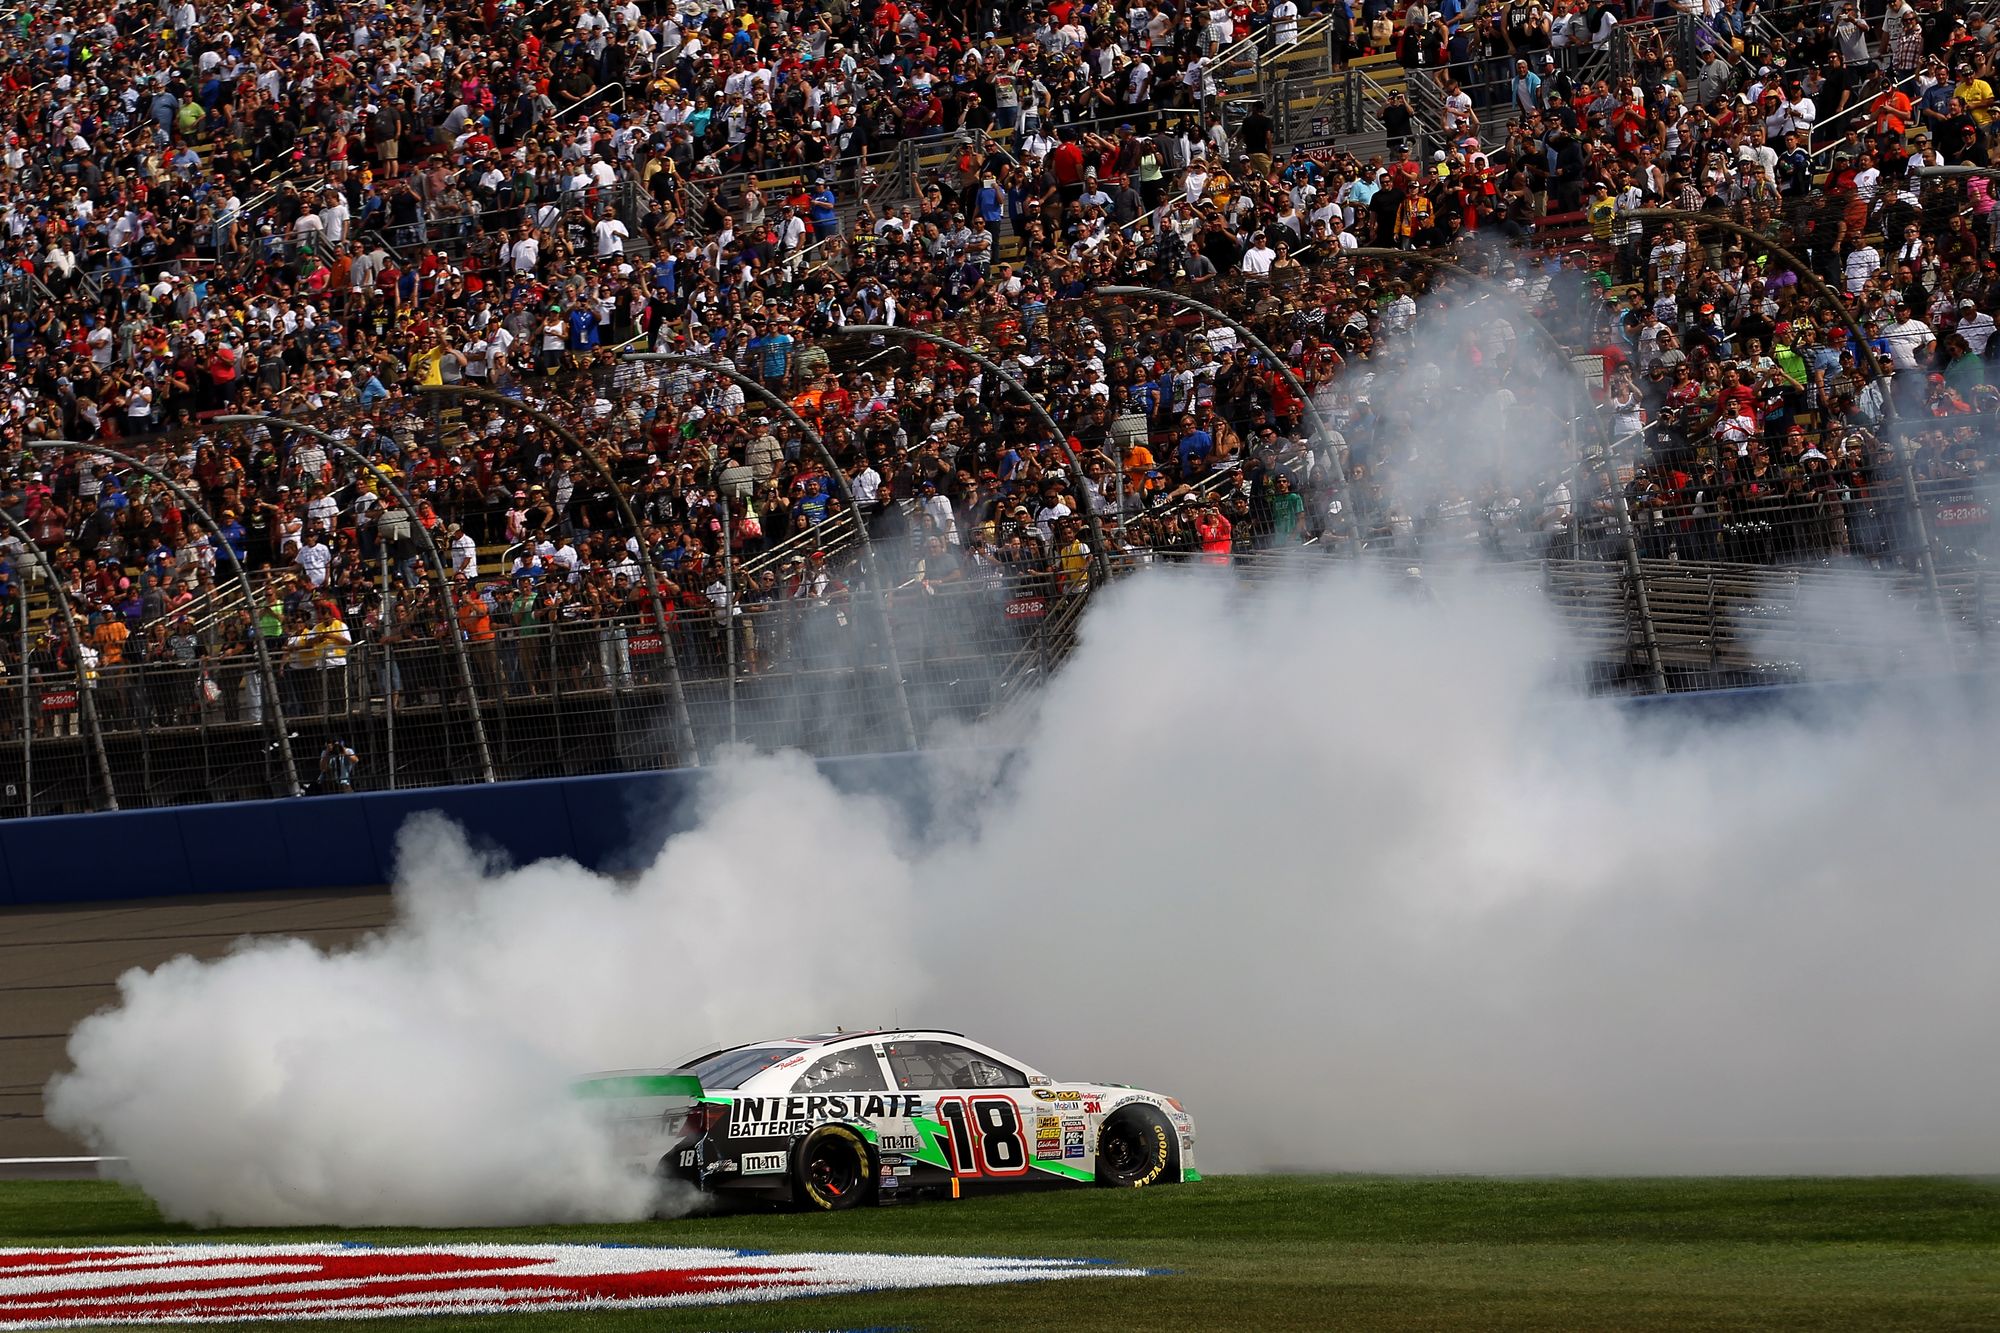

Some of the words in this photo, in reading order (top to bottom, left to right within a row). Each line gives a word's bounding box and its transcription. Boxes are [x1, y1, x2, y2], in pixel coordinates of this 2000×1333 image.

[732, 1094, 922, 1122] INTERSTATE
[1083, 1102, 1102, 1113] 3M
[730, 1120, 814, 1137] BATTERIES
[936, 1095, 1030, 1177] 18
[1038, 1129, 1061, 1138] JEGS
[679, 1150, 695, 1167] 18
[1133, 1124, 1168, 1188] GOODYEAR
